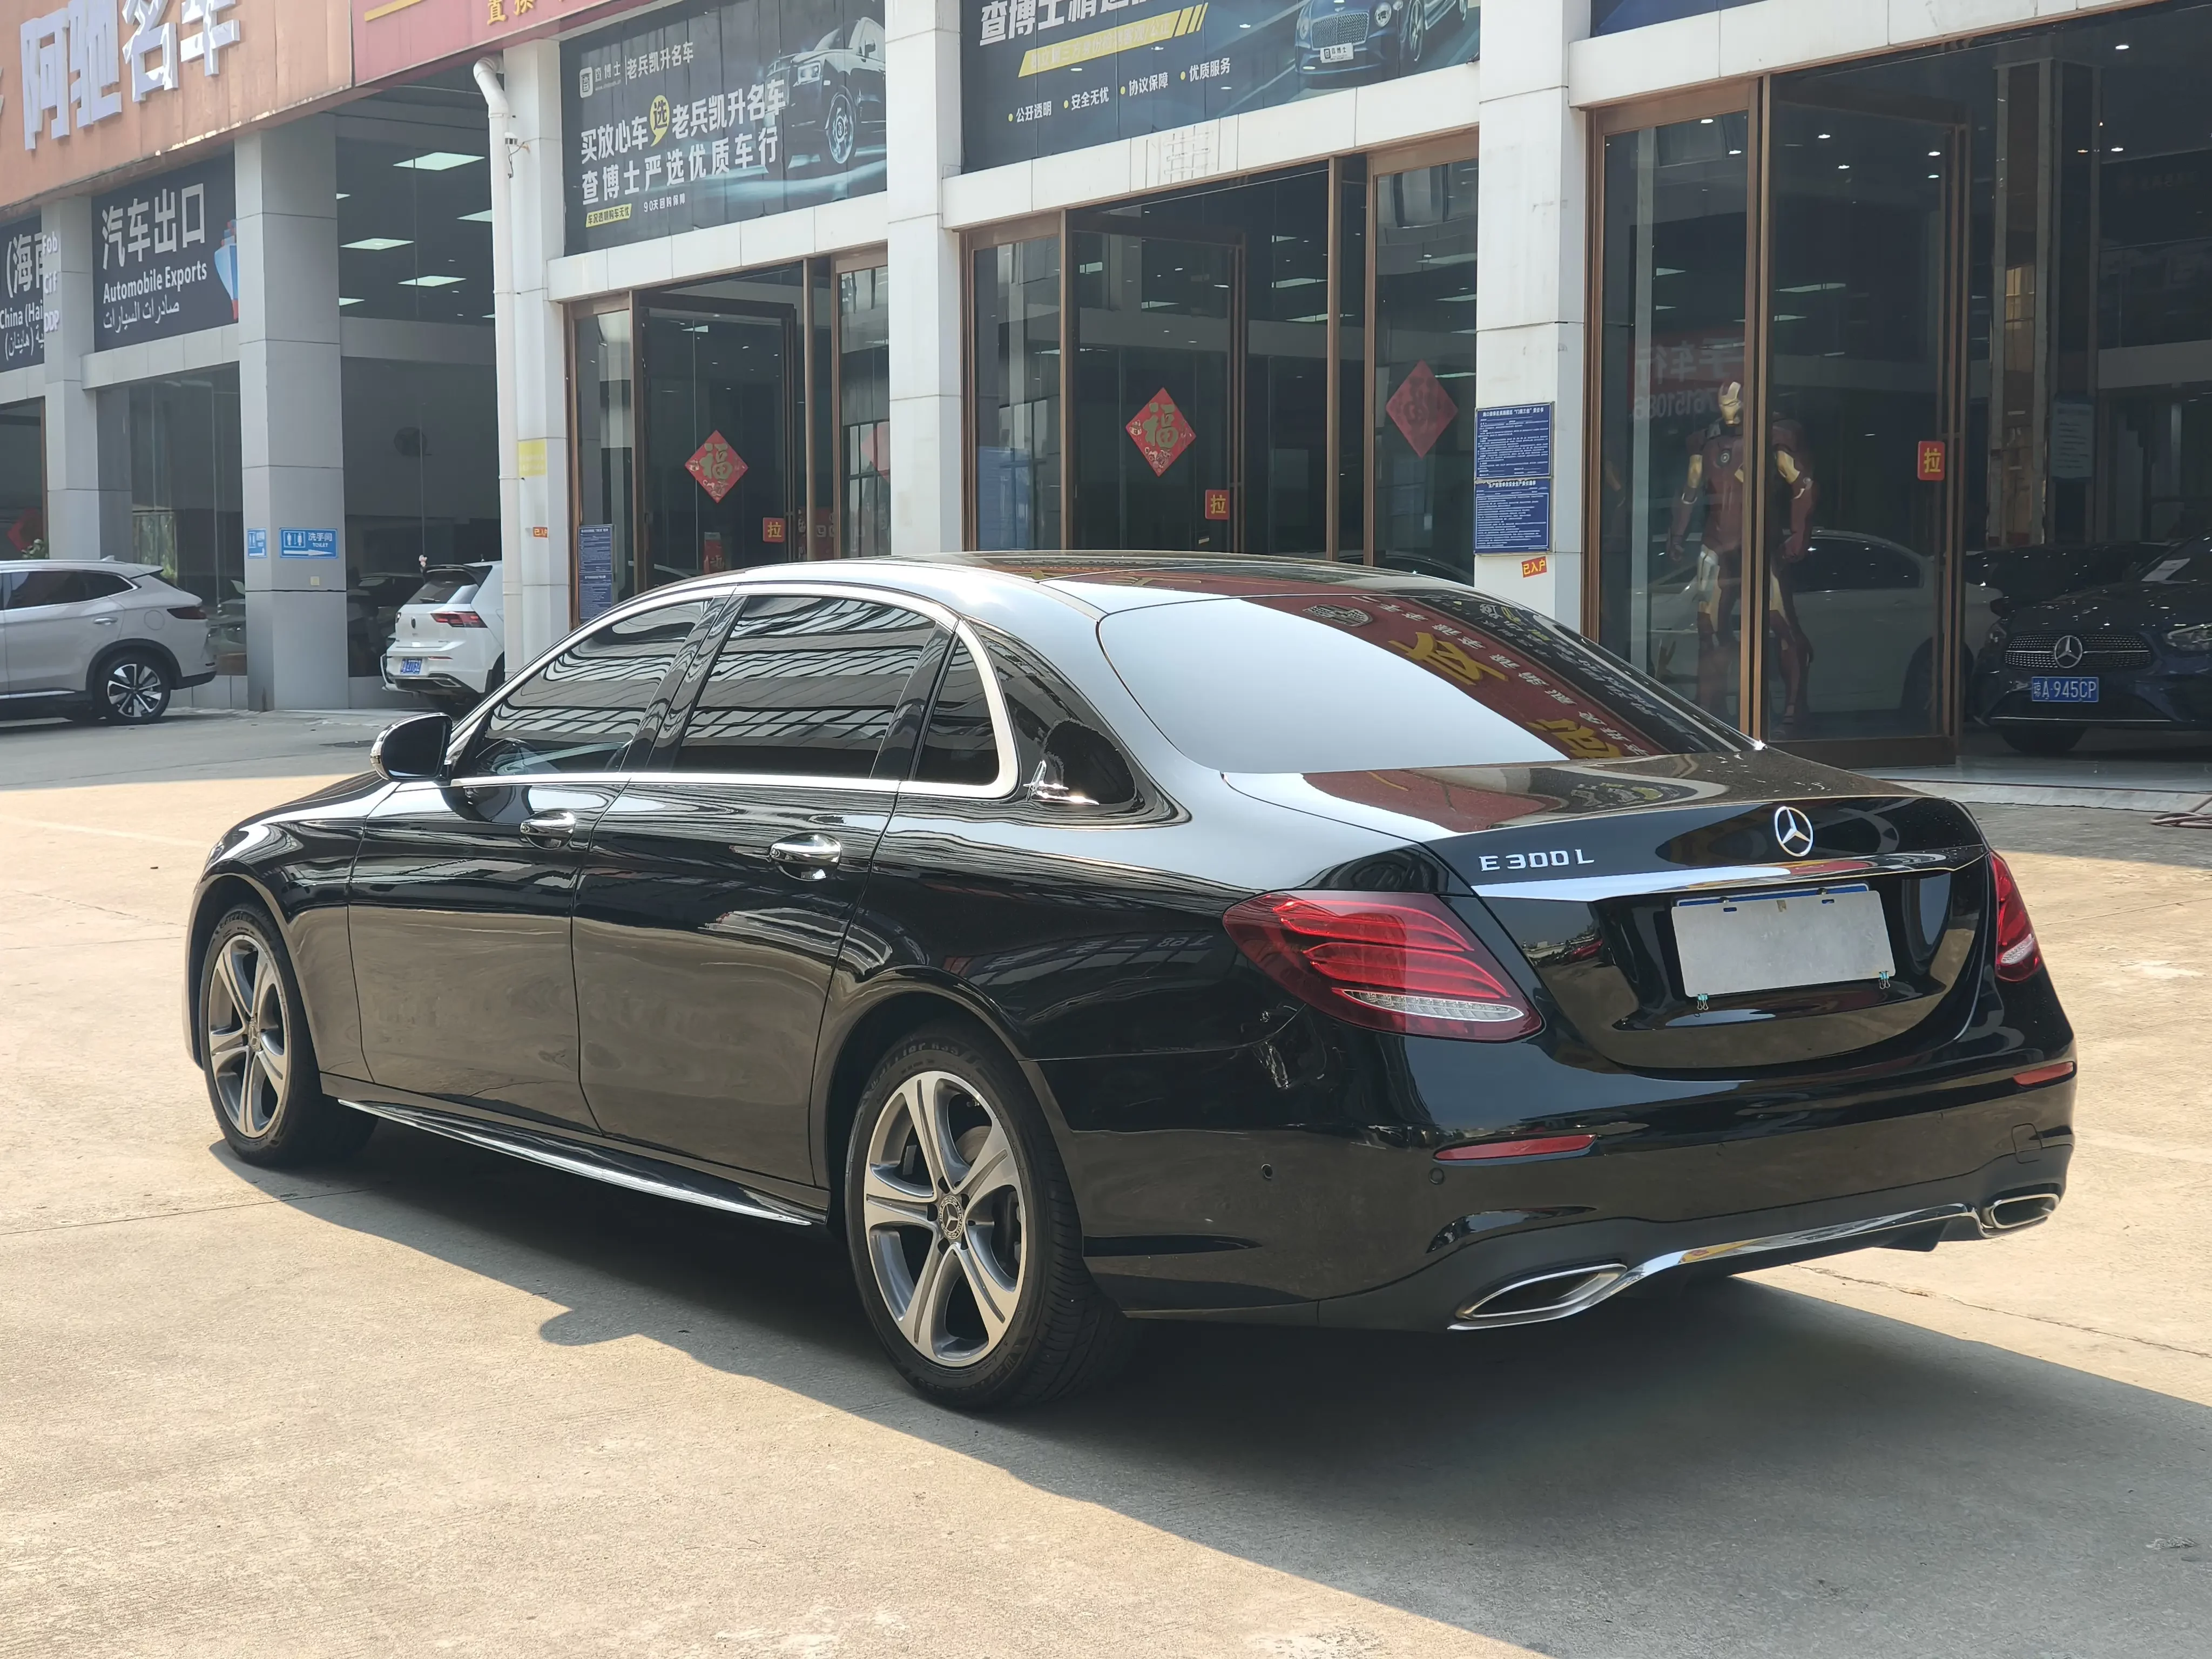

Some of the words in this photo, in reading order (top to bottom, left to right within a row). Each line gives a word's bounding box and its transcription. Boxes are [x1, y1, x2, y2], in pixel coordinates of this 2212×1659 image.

[627, 42, 693, 79] 老兵凯升名车
[1189, 57, 1231, 83] 优质服务
[1129, 72, 1169, 96] 协议保障
[1071, 86, 1109, 111] 安全无忧
[1016, 101, 1052, 123] 公开透明
[582, 126, 778, 205] 查博士严选优质车行
[102, 183, 205, 270] 汽车出口
[103, 268, 163, 304] Automobile
[165, 260, 207, 292] Exports
[0, 307, 23, 329] China
[44, 309, 59, 333] DDP
[1143, 402, 1179, 448] 福
[699, 442, 733, 480] 福
[1924, 448, 1941, 473] 拉
[1210, 494, 1226, 515] 拉
[308, 532, 332, 542] 洗手间
[767, 521, 782, 538] 拉
[1523, 559, 1546, 575] 已入户
